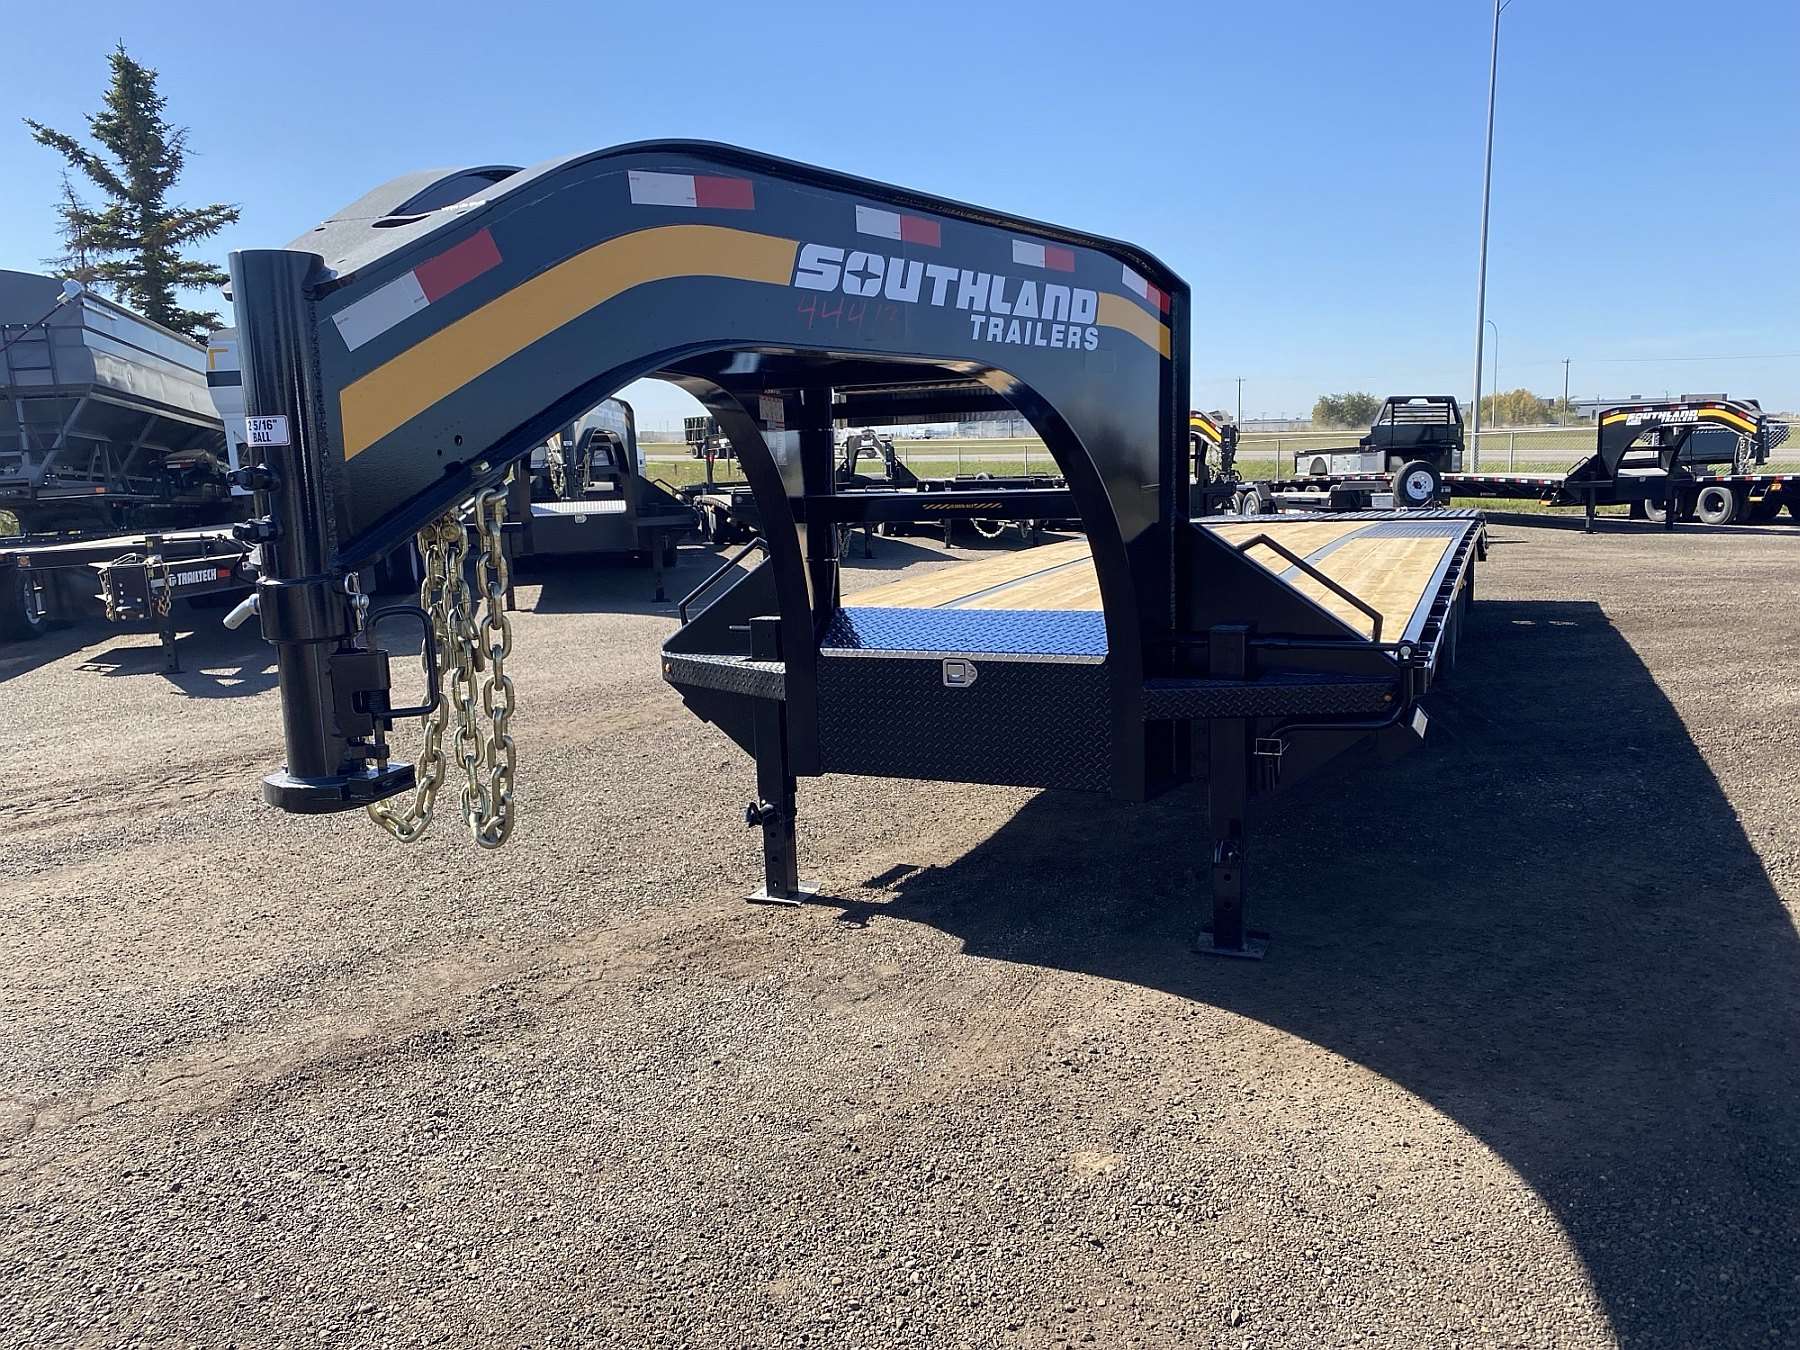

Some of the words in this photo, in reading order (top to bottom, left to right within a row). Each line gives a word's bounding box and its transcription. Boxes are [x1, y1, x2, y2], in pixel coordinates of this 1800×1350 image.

[794, 243, 1099, 326] SOUTHLAND
[969, 314, 1099, 351] TRAILERS
[253, 432, 272, 443] BALL
[176, 568, 217, 586] TRAILTECH
